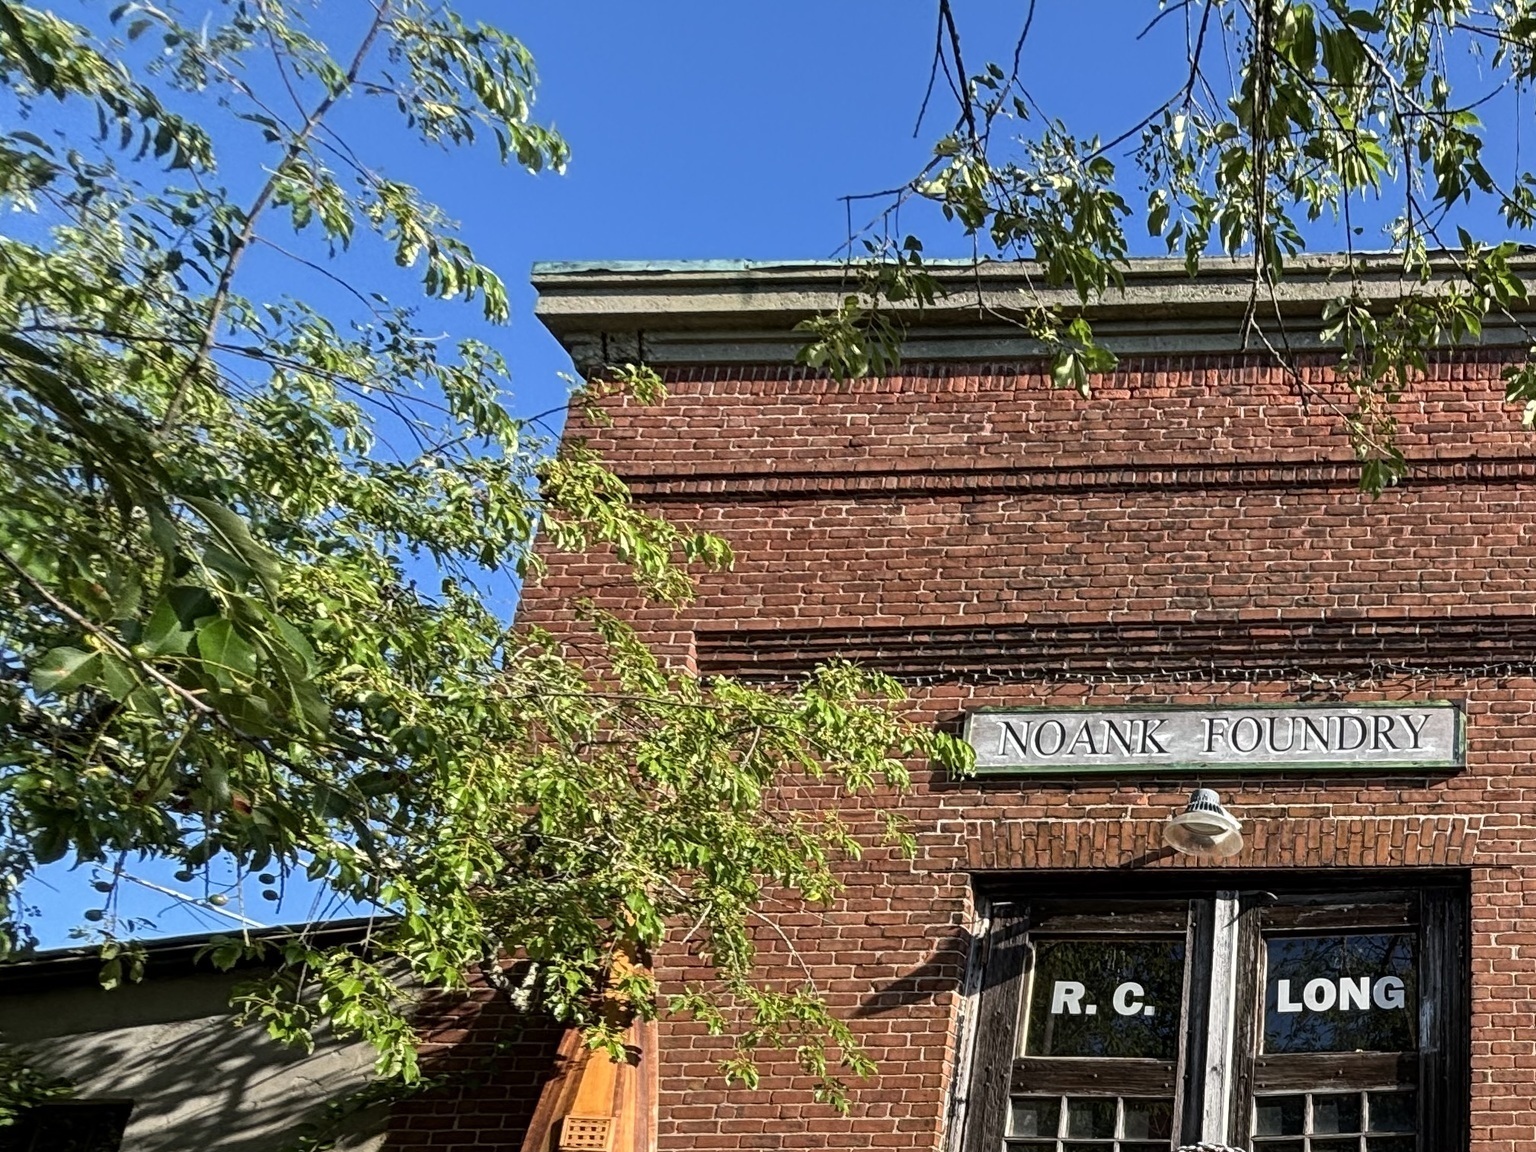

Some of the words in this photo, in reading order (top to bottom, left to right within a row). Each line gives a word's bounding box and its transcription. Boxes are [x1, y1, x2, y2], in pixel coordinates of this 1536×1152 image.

[998, 717, 1168, 757] NOANK
[1202, 713, 1432, 754] FOUNDRY
[1050, 981, 1097, 1014] R.
[1113, 981, 1155, 1016] C.
[1278, 976, 1405, 1012] LONG
